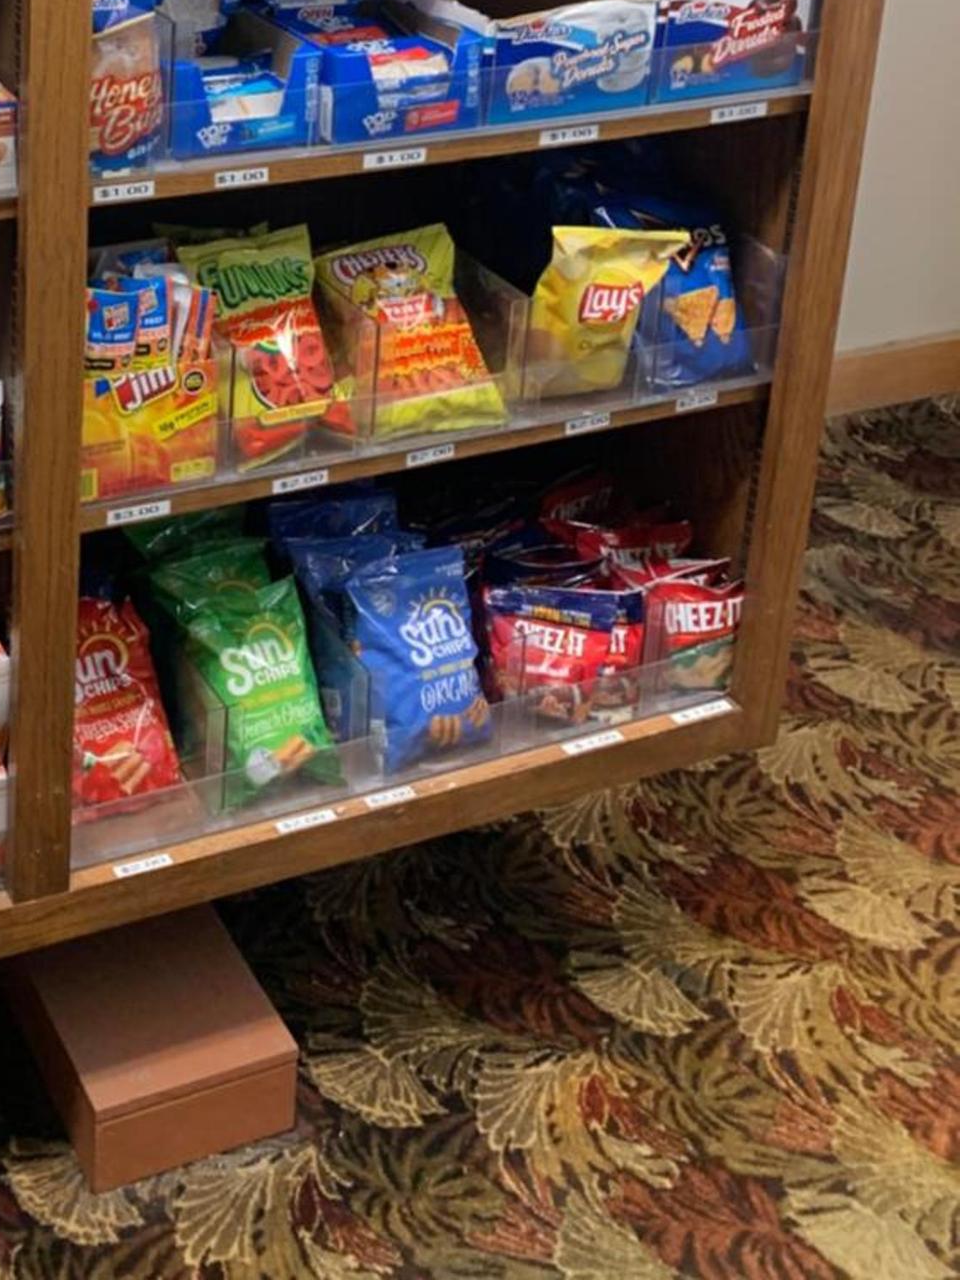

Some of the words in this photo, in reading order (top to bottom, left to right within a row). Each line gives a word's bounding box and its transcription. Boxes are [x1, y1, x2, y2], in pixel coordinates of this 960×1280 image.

[298, 6, 335, 21] OPEN
[376, 151, 422, 165] $1.00
[217, 170, 265, 184] $1.00
[100, 184, 150, 198] $1.00
[581, 283, 641, 323] Lay's
[399, 607, 469, 666] Sun
[219, 637, 296, 696] Sun
